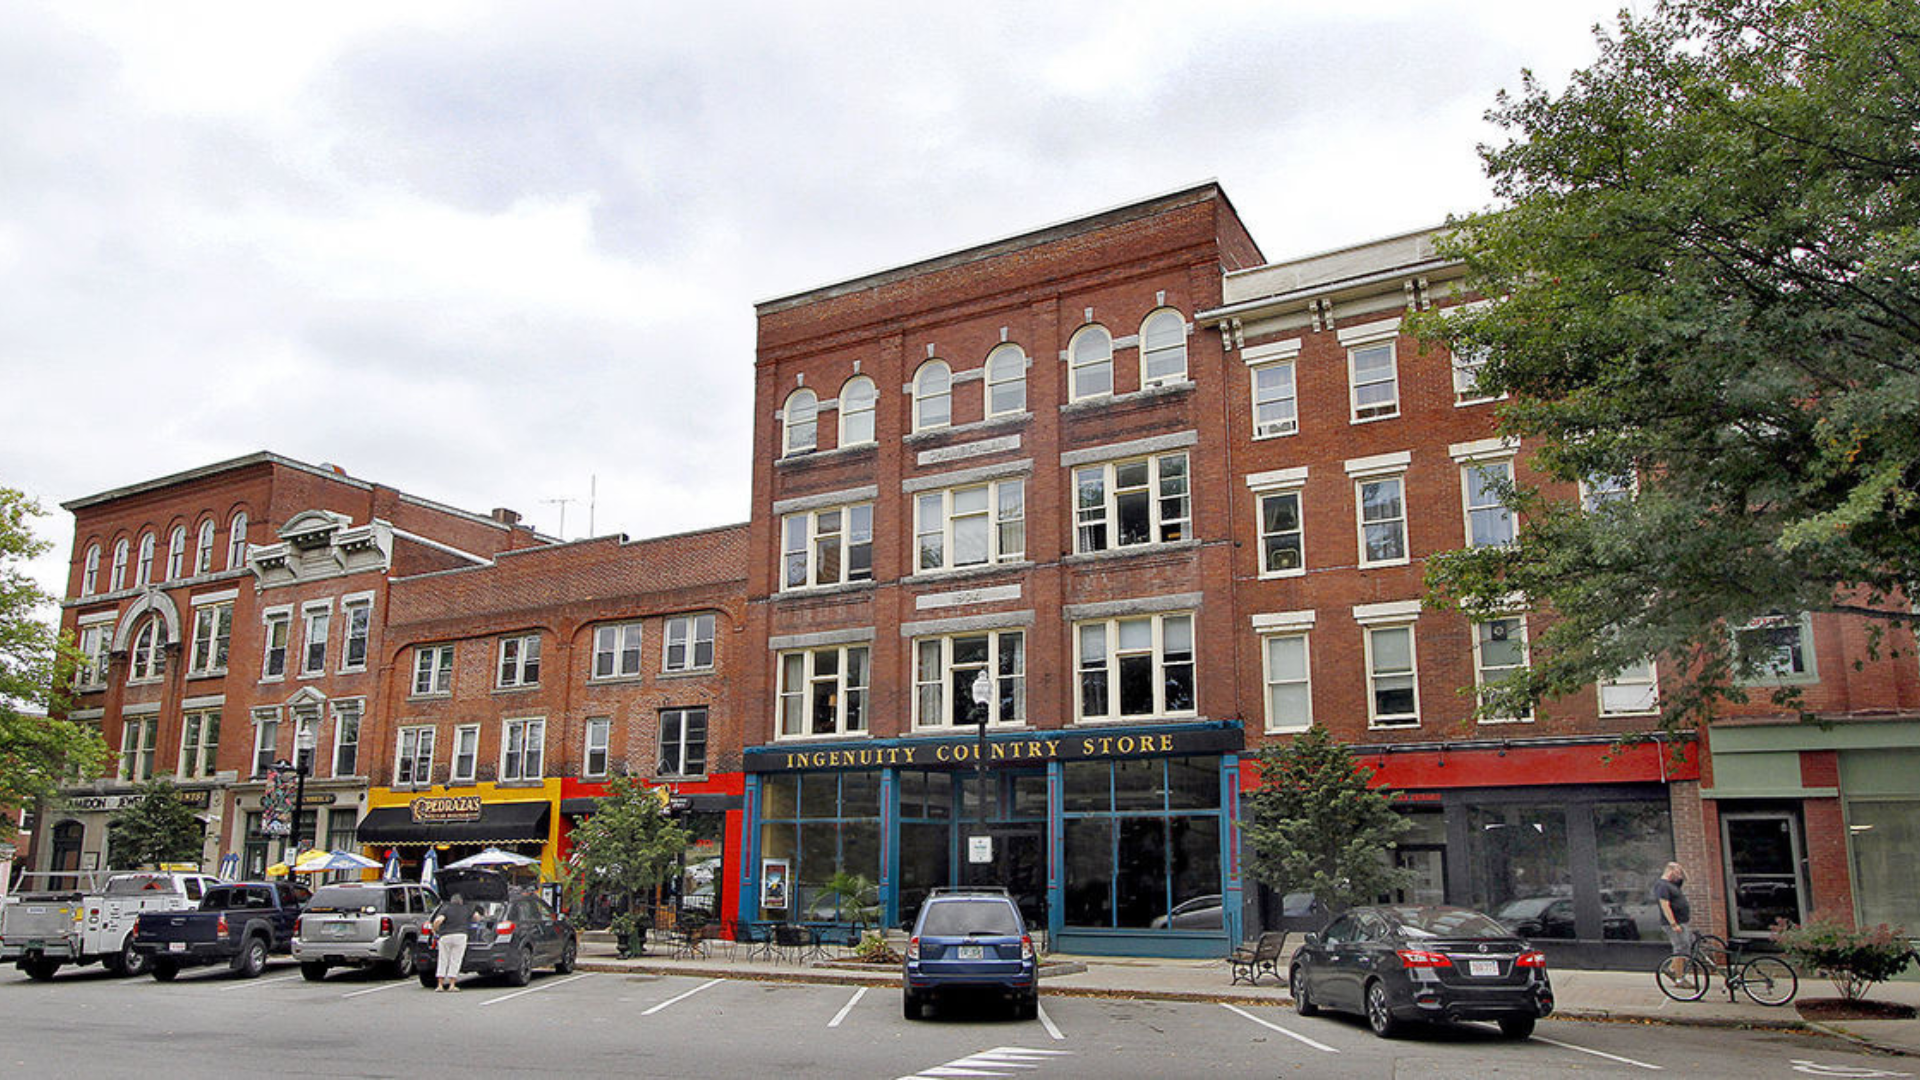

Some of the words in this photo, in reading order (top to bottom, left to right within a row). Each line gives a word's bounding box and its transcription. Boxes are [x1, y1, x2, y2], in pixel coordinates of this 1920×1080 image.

[786, 747, 916, 768] INGENUITY
[936, 740, 1061, 762] COUNTRY
[1082, 734, 1174, 756] STORE
